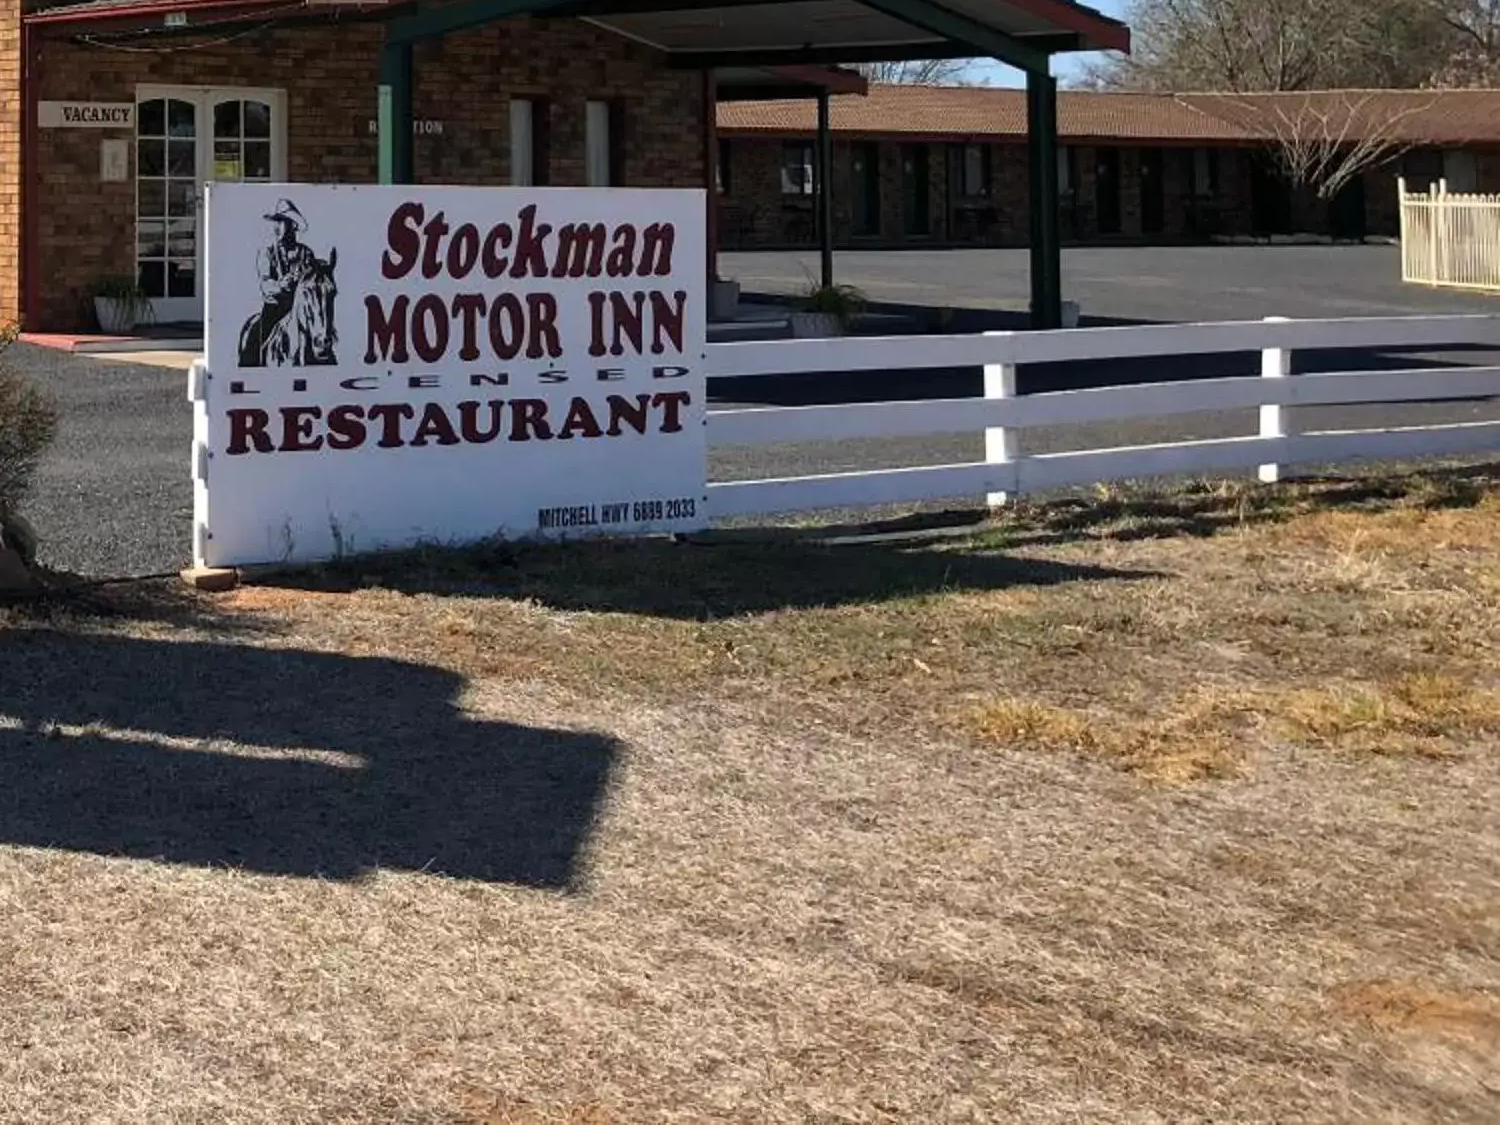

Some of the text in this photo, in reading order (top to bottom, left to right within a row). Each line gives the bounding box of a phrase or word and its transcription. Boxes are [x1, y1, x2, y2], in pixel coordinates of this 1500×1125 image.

[63, 106, 130, 123] VACANCY
[381, 201, 676, 280] Stockman
[363, 290, 687, 365] MOTOR INN
[230, 365, 690, 394] LICENSED
[225, 391, 691, 456] RESTAURANT
[537, 504, 598, 528] MITCHELL
[601, 502, 629, 524] HWY
[665, 498, 696, 520] 2033
